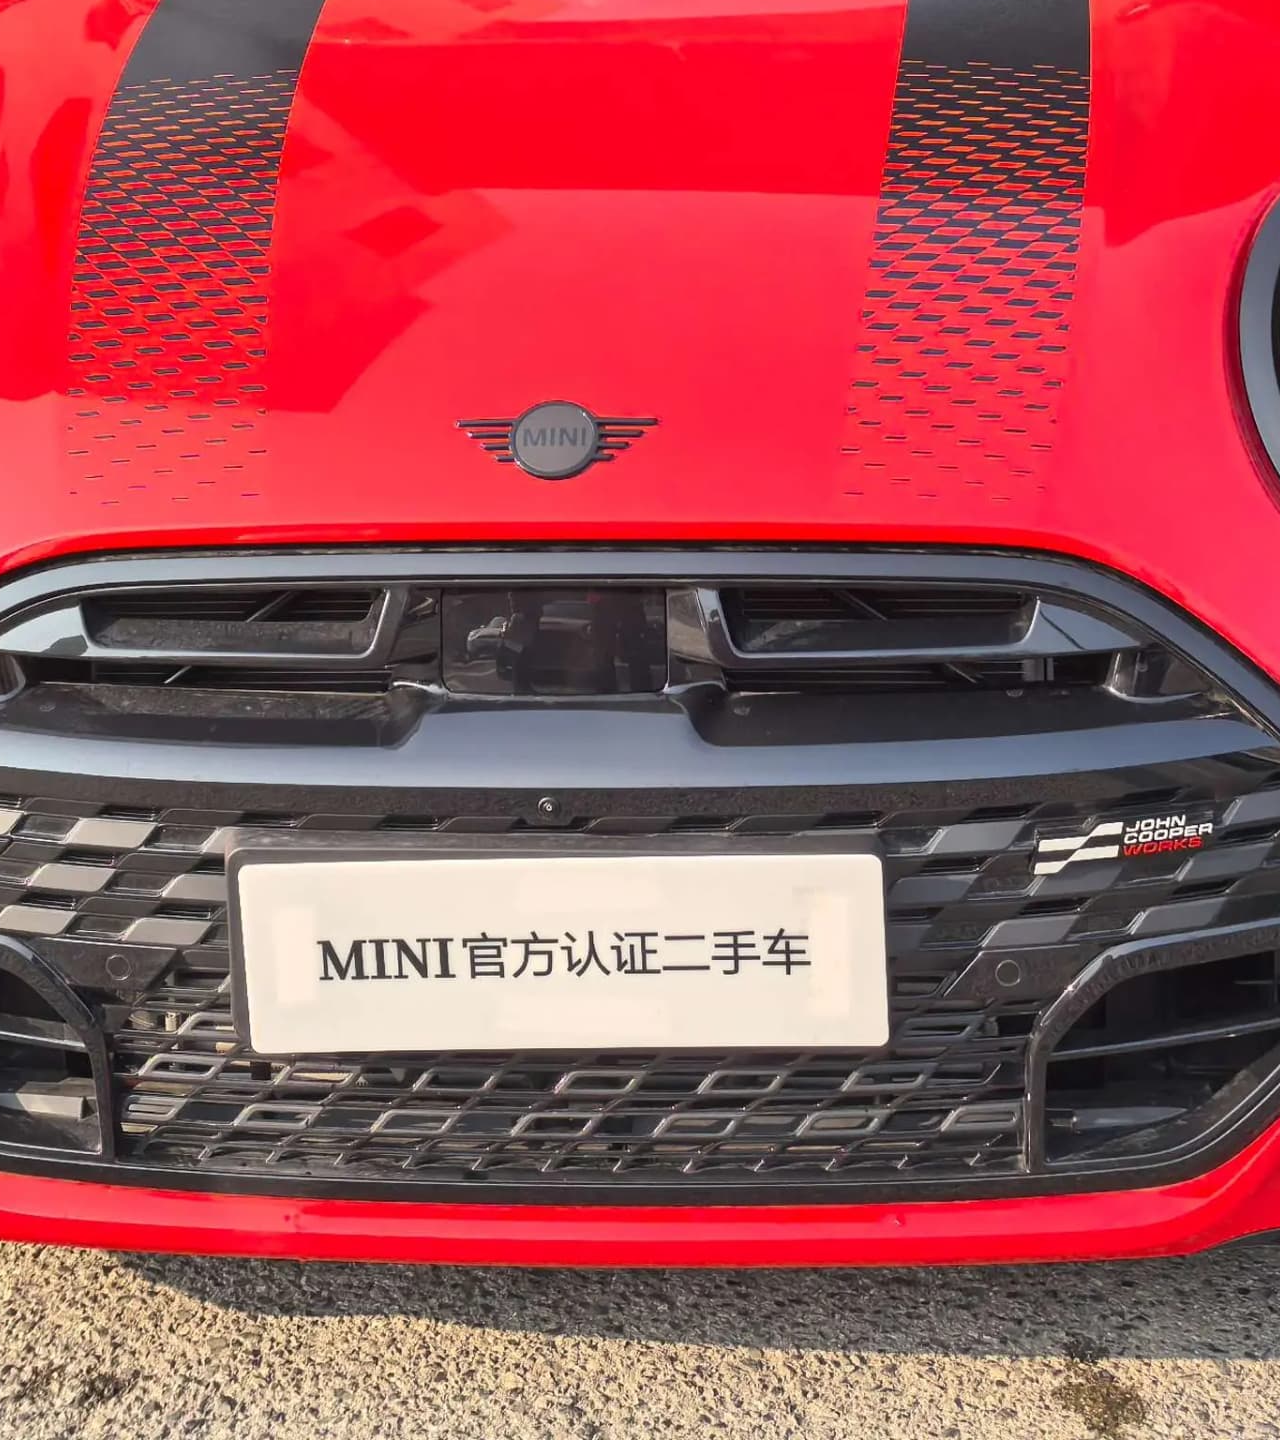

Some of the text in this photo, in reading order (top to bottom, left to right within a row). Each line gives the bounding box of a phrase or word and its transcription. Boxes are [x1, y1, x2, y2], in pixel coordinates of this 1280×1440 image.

[523, 427, 587, 447] MINI
[1124, 823, 1213, 844] COOPER
[1126, 815, 1186, 832] JOHN
[1123, 835, 1202, 856] WORKS
